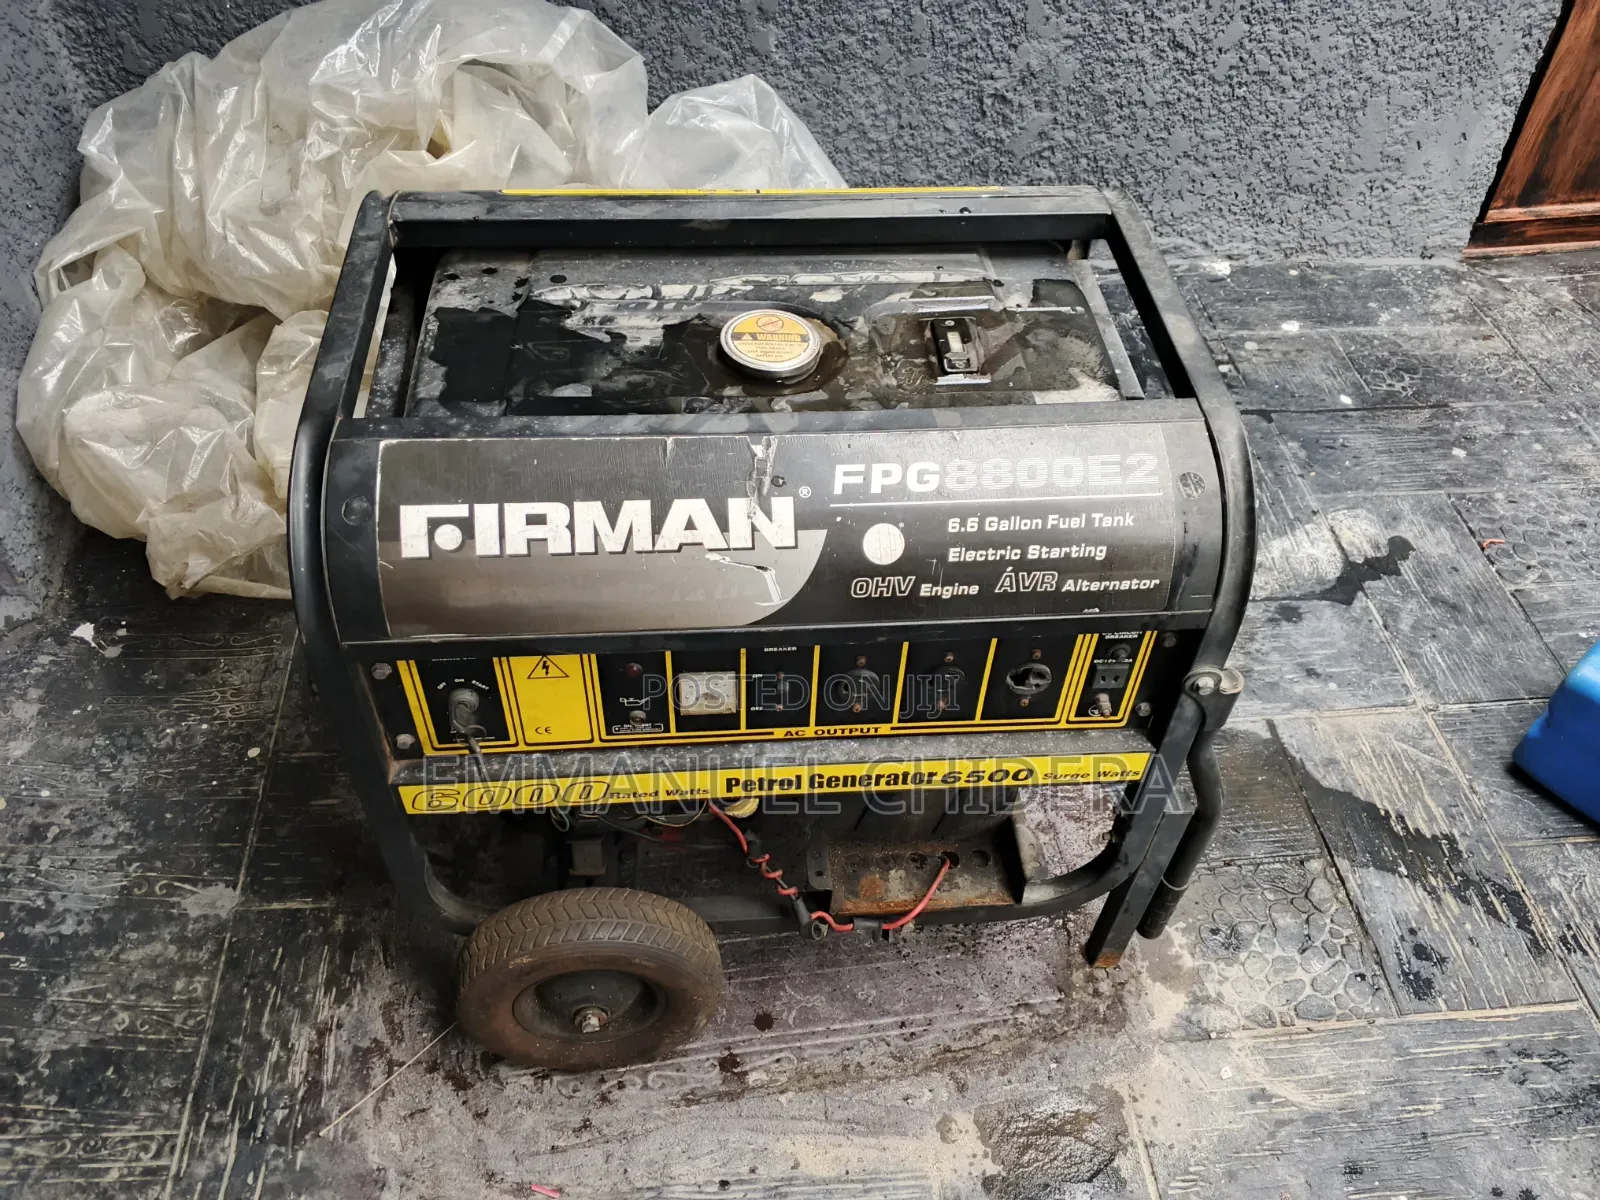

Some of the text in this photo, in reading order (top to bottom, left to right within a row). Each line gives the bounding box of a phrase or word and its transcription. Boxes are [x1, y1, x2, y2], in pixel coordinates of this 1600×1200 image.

[756, 333, 802, 342] WARNING
[833, 453, 1159, 495] FPG8800E2
[400, 496, 796, 558] FIRMAN
[984, 516, 1042, 532] Gallon
[1047, 513, 1086, 529] Fuel
[1091, 512, 1135, 528] Tank
[948, 543, 1107, 562] Electric Starting
[851, 576, 916, 598] OHV
[919, 583, 980, 599] Engine
[1061, 577, 1160, 592] Alternator
[814, 727, 882, 736] OUTPUT
[726, 768, 1140, 794] Petrol Generator 6500 Surge Watts
[412, 781, 710, 812] 6000 Rated Watts
